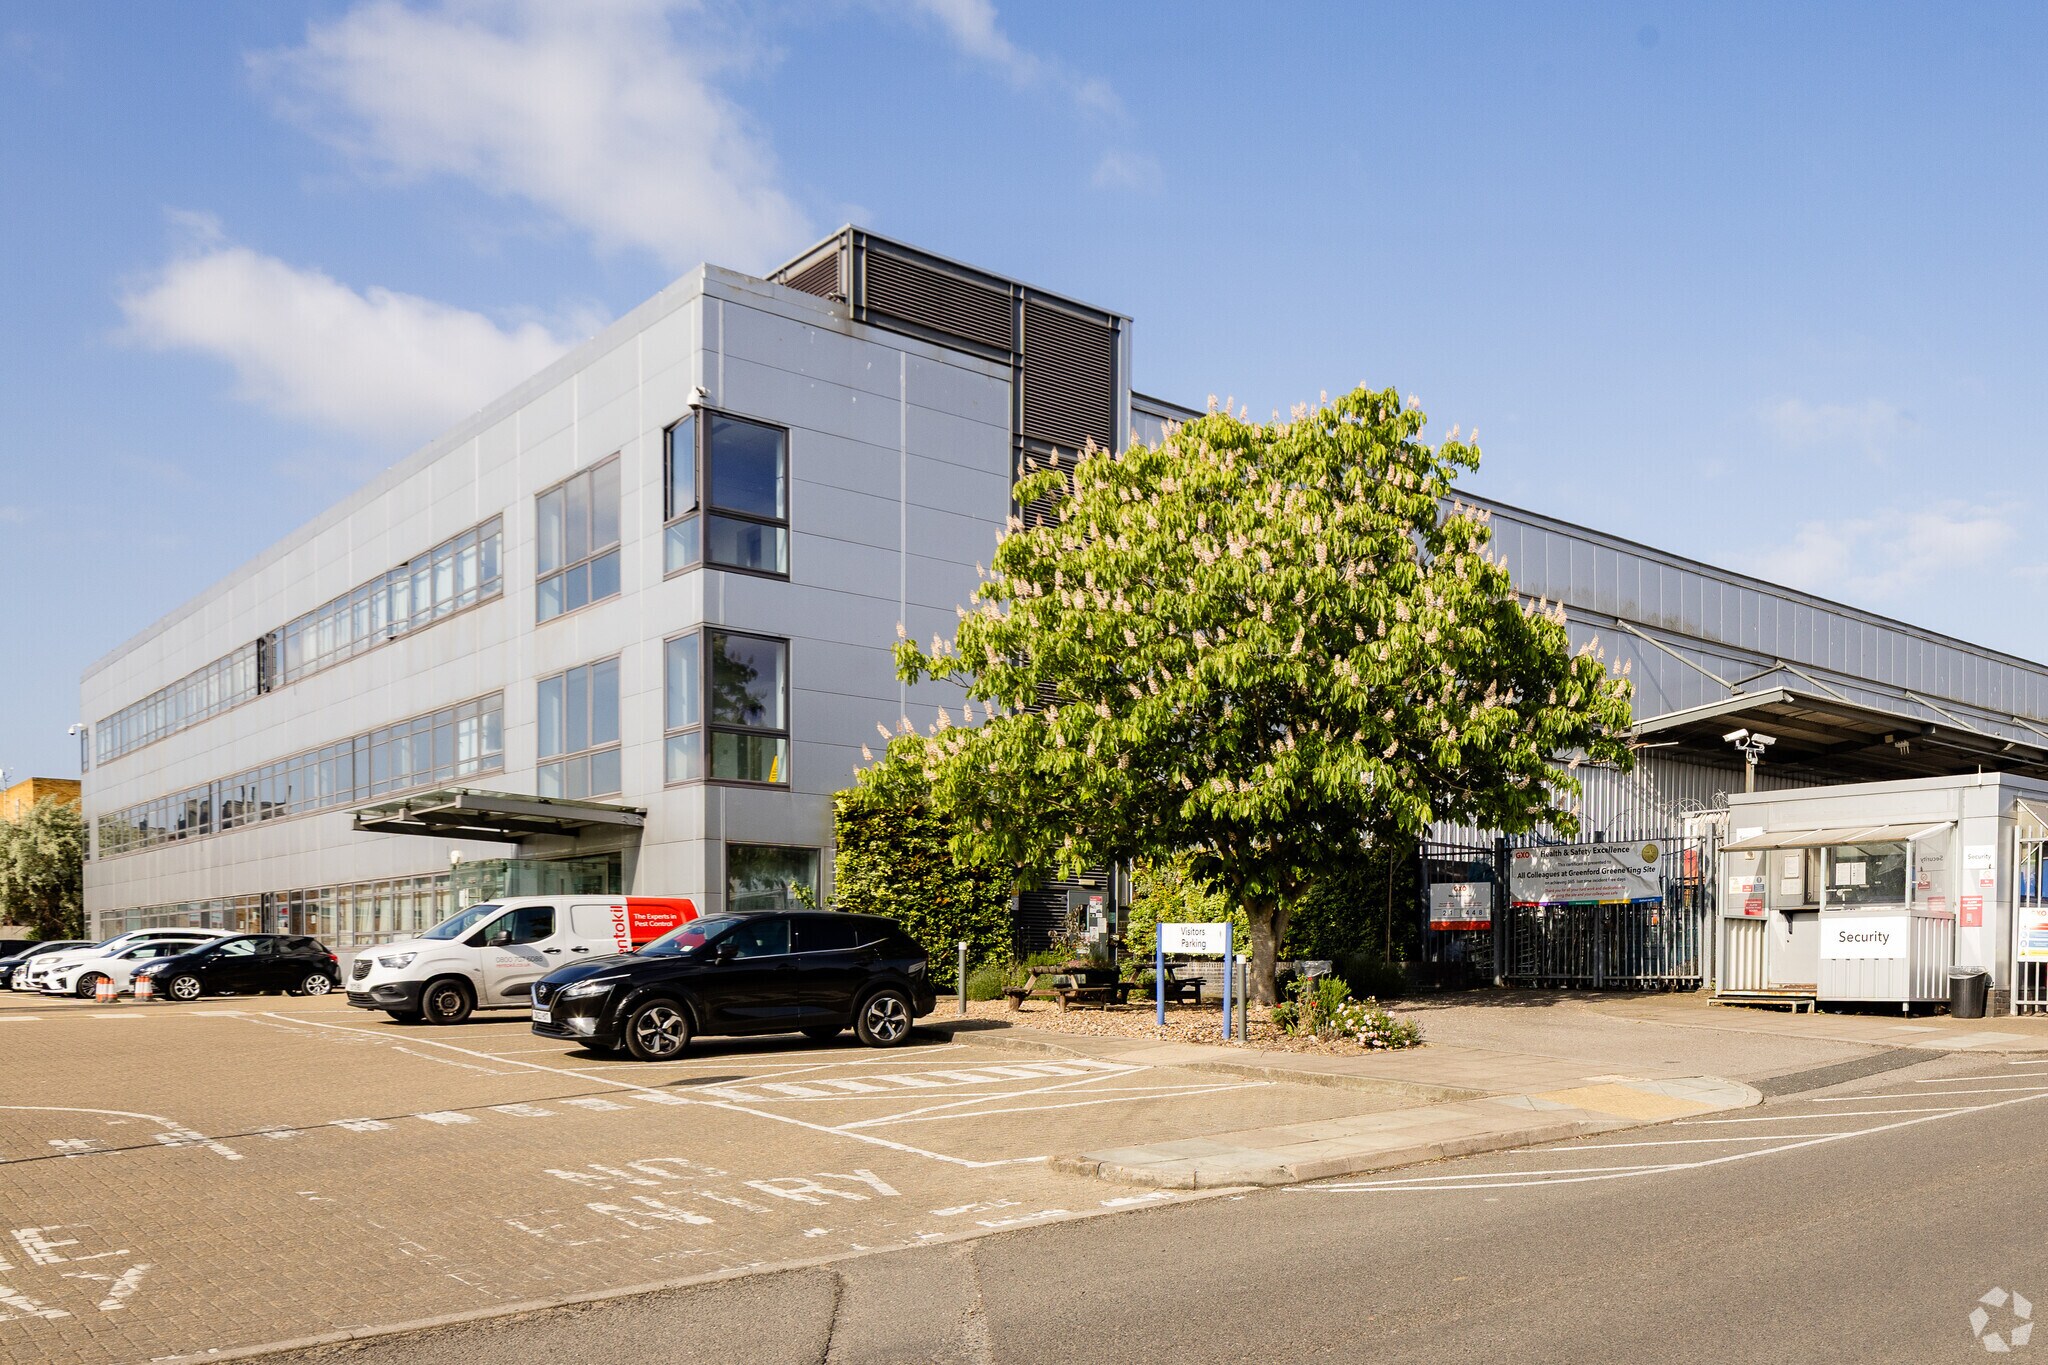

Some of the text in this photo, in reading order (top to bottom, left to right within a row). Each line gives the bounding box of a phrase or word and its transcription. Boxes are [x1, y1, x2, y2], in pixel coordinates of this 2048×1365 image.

[1570, 848, 1592, 856] Safety
[1592, 845, 1630, 854] Excellence
[1967, 853, 1992, 861] Security
[1526, 871, 1560, 879] Colleagues
[1568, 867, 1600, 877] Greenford
[1601, 867, 1626, 875] Greene
[1643, 865, 1656, 873] Site
[646, 913, 670, 921] Experts
[610, 905, 628, 954] entokil
[1181, 926, 1206, 936] Visitors
[1838, 930, 1890, 946] Security
[1181, 938, 1206, 950] Parking
